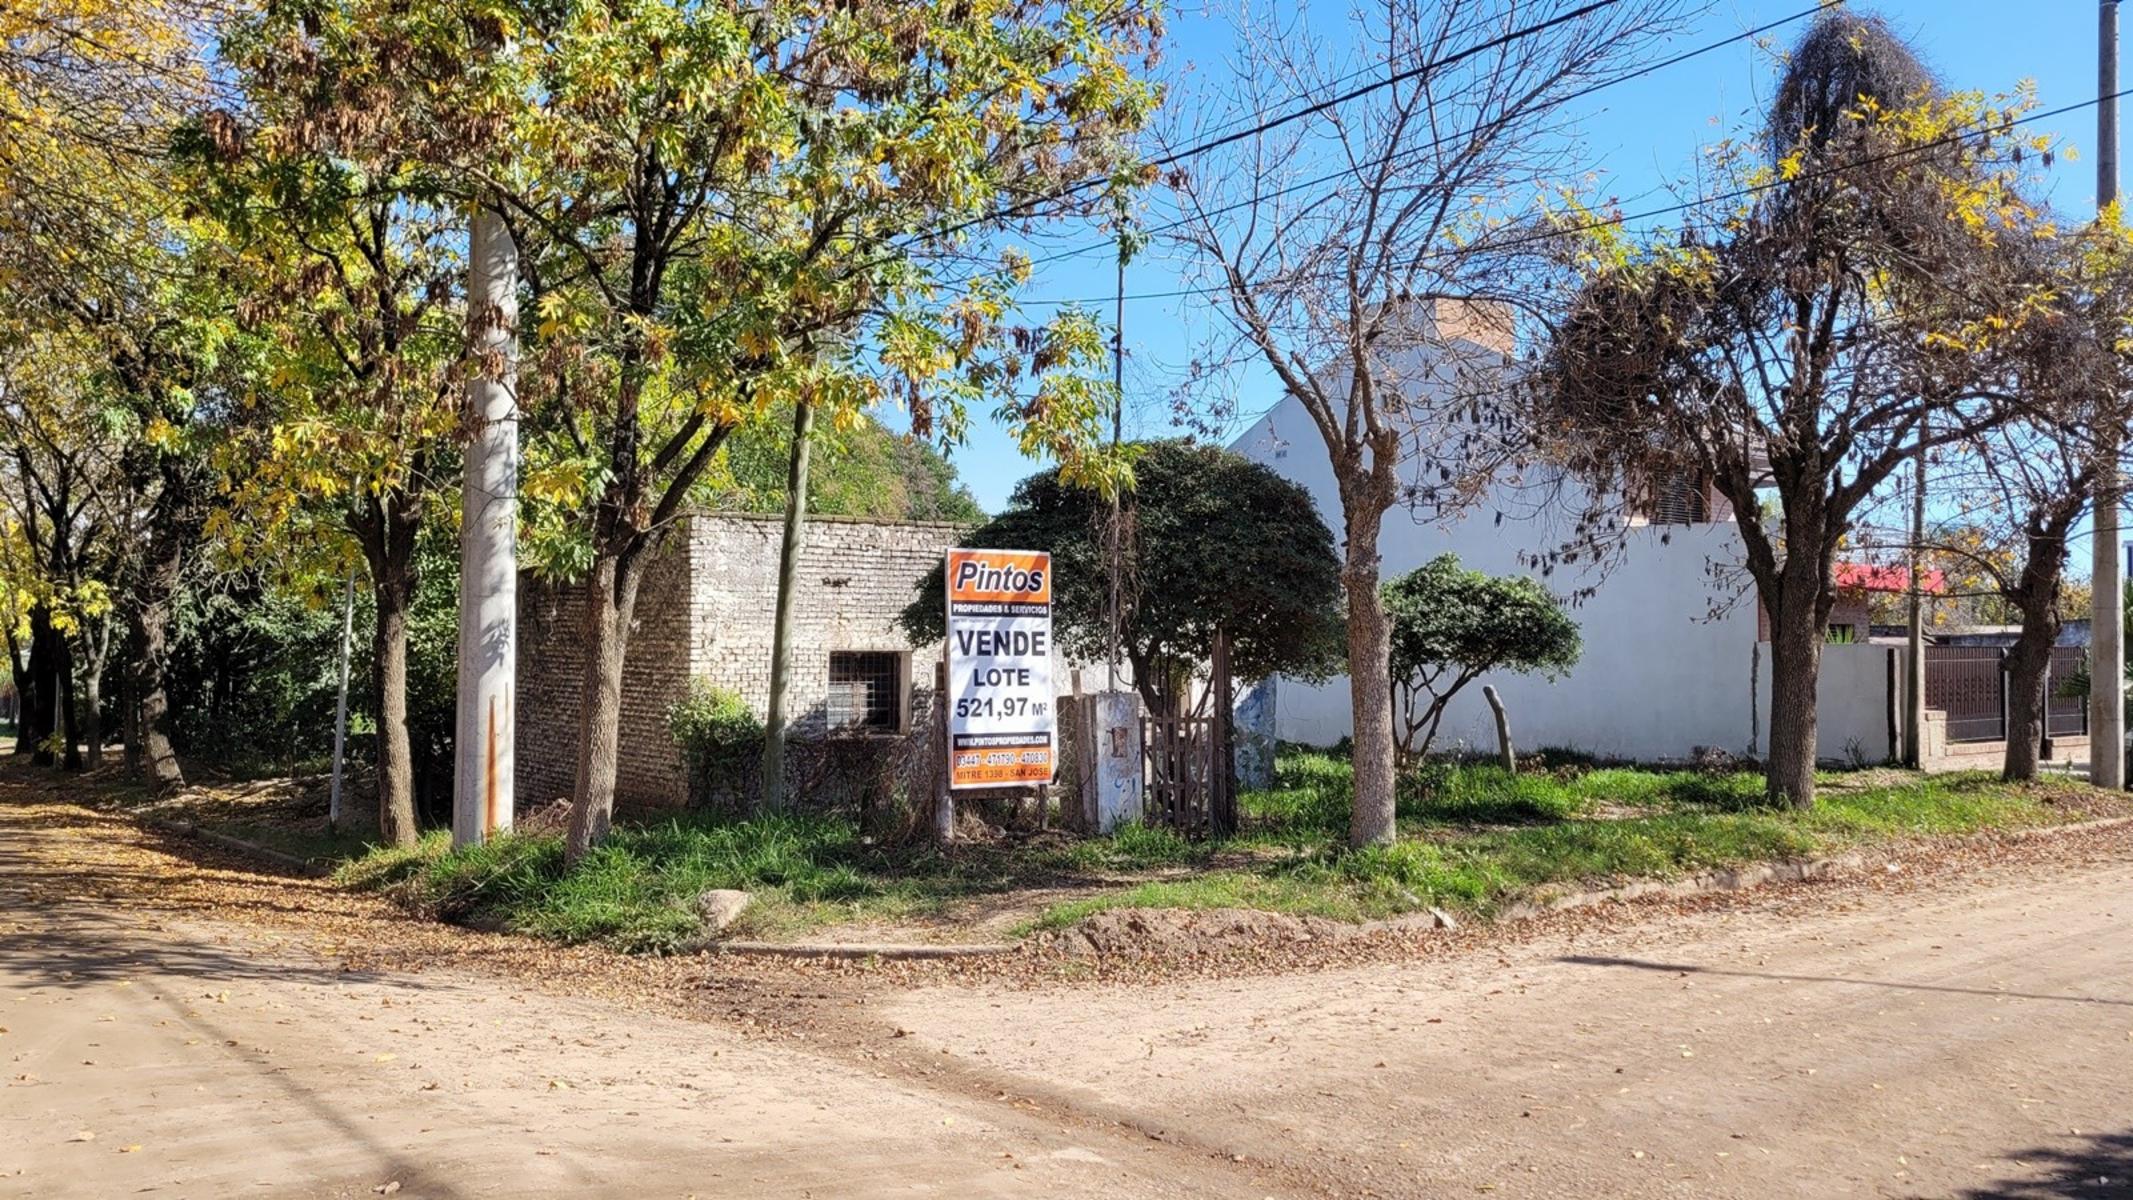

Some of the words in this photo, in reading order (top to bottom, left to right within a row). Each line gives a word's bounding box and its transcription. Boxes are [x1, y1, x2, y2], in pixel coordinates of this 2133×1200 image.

[955, 560, 1045, 594] Pintos
[953, 603, 1002, 614] PROPIEDADES
[1004, 605, 1010, 614] &
[1011, 605, 1048, 615] SERVICIOS
[957, 630, 1046, 656] VENDE
[974, 668, 1030, 687] LOTE
[957, 697, 1028, 721] 521,97
[957, 735, 1048, 747] WWW.PINTOSPROPIEDADES.COM
[956, 753, 981, 768] 03447
[957, 770, 982, 780] MITRE
[1010, 768, 1026, 778] SAN
[1028, 767, 1049, 777] JOSE
